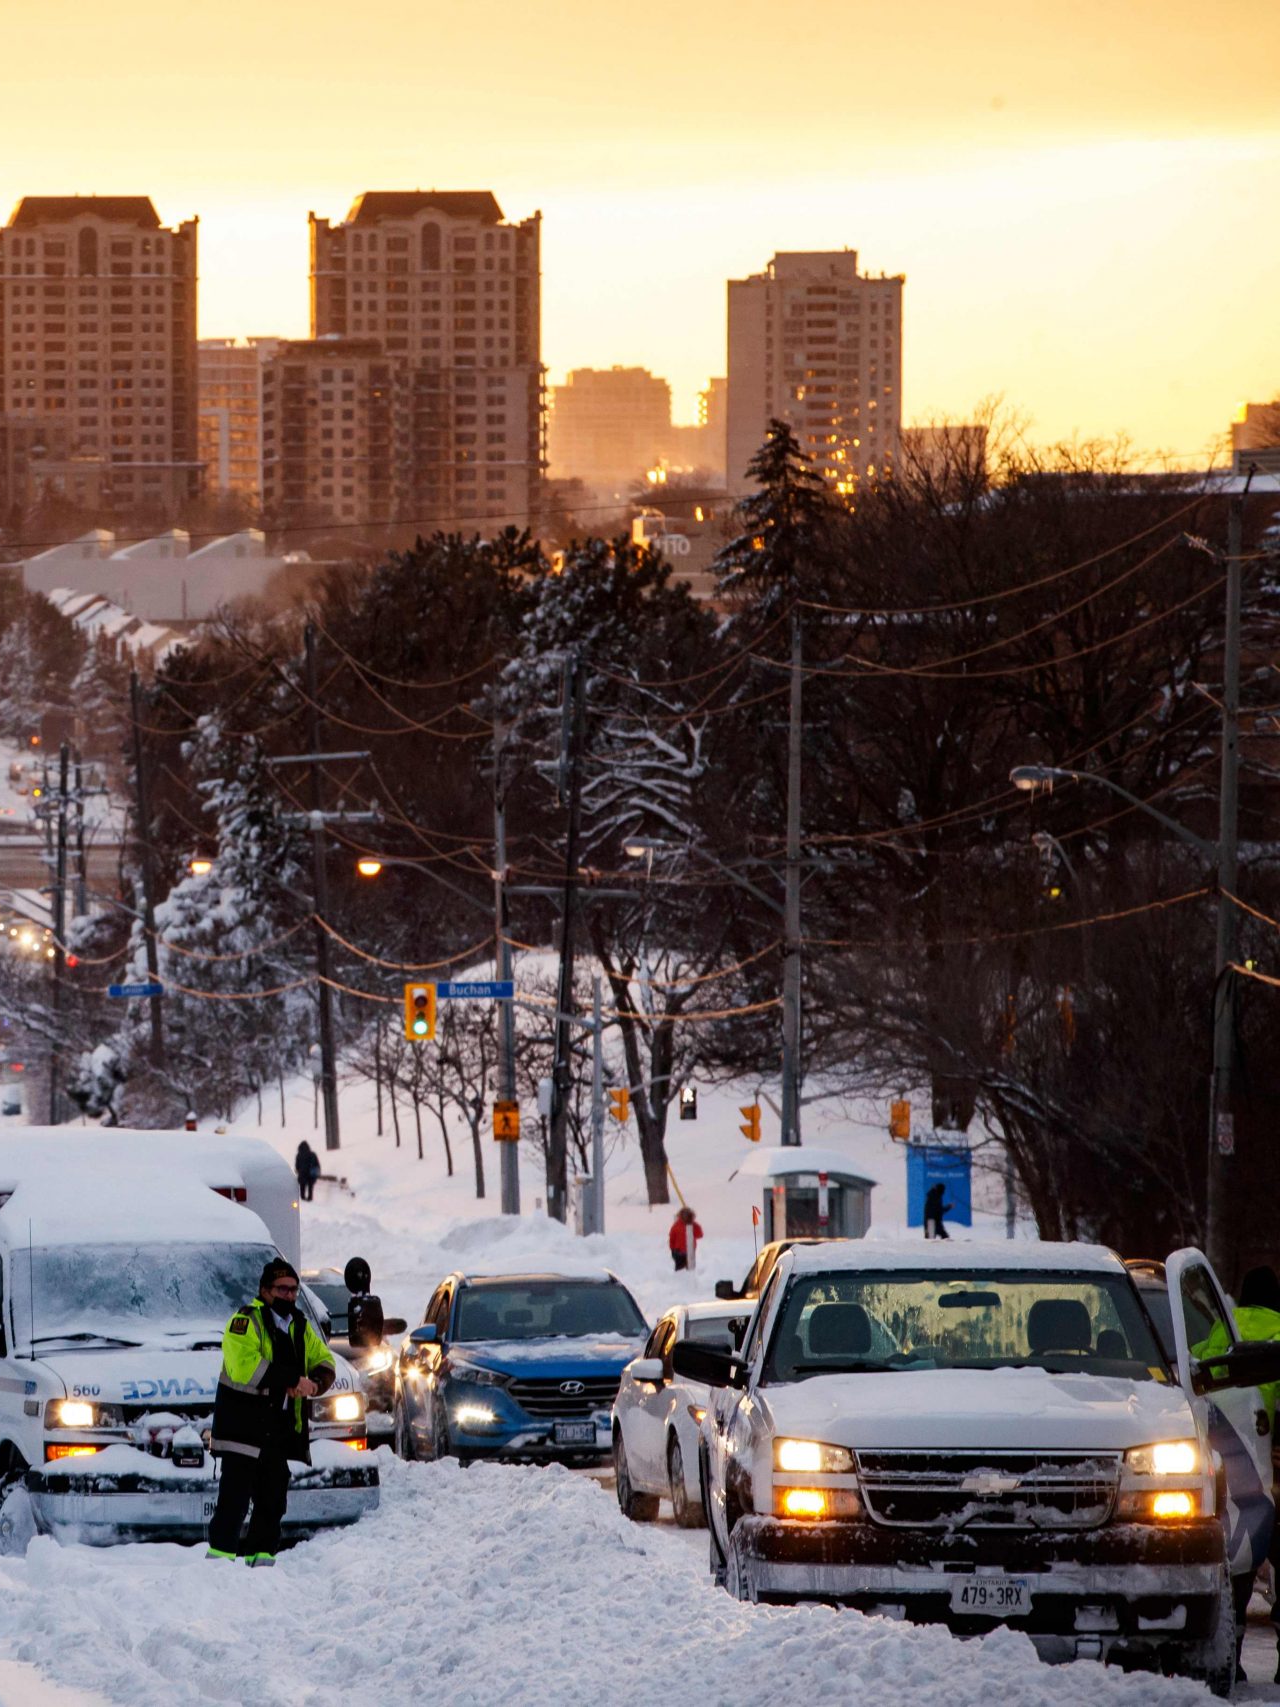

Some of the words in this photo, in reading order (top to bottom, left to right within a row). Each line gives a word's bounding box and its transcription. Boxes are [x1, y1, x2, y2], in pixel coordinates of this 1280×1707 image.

[449, 983, 492, 996] Buchan
[72, 1384, 101, 1398] 560
[961, 1586, 987, 1605] 479
[996, 1586, 1022, 1606] 3RX
